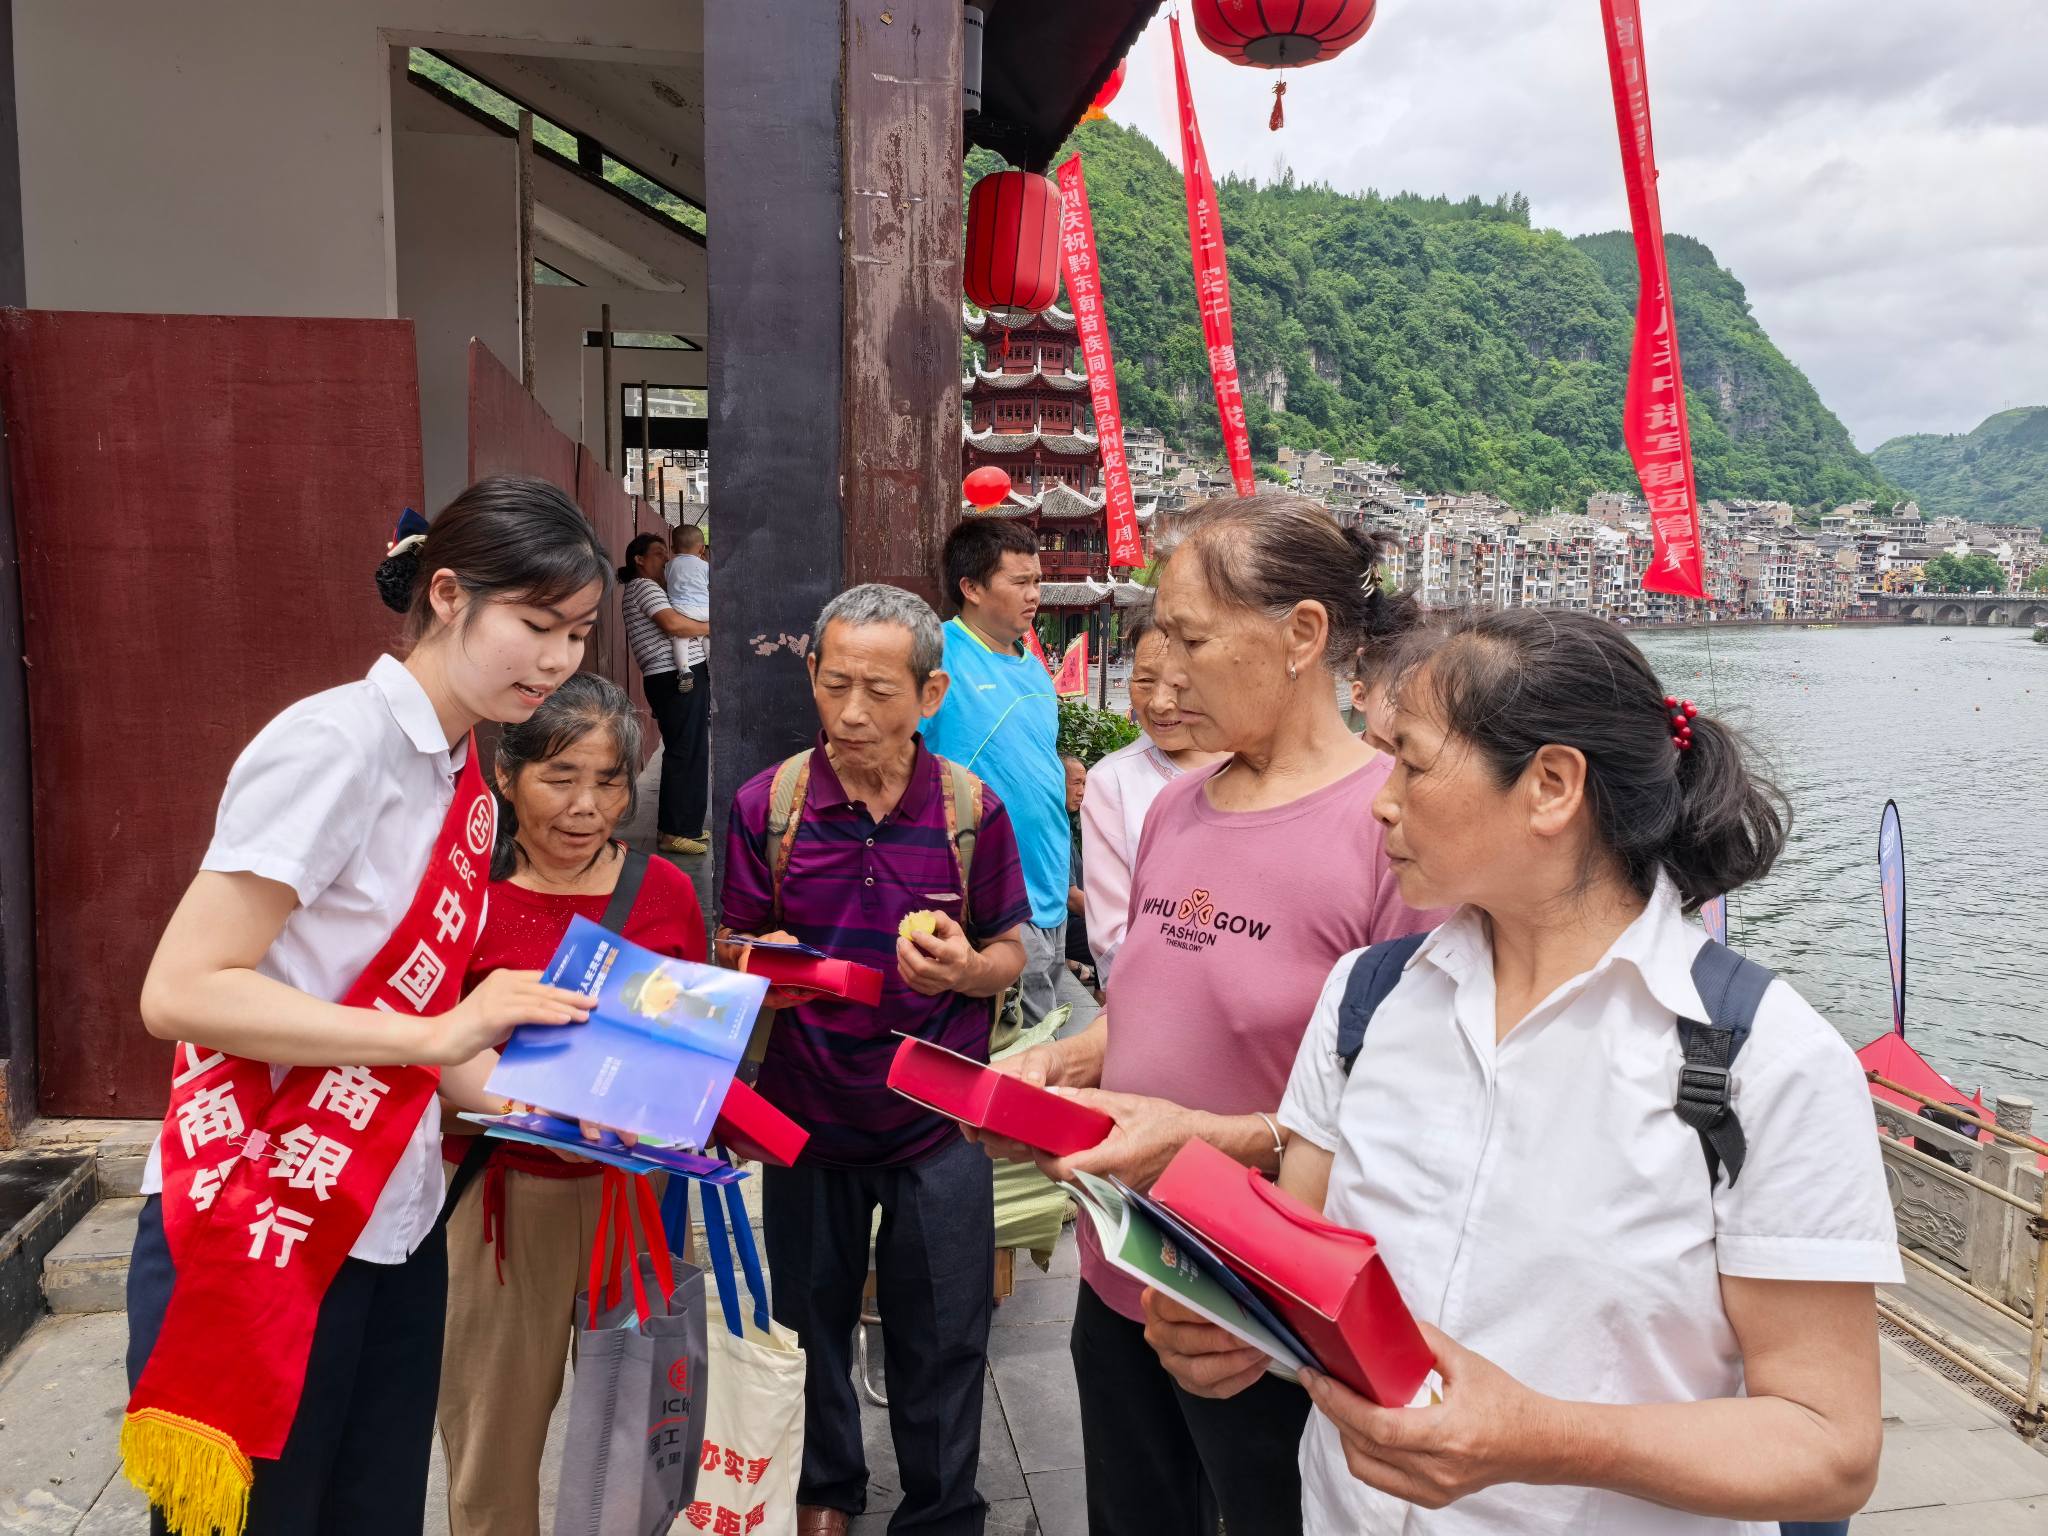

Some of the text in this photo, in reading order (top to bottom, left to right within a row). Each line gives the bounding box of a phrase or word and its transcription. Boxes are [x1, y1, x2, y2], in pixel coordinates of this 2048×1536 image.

[448, 843, 478, 890] ICBC
[1142, 898, 1272, 941] WHU GOW
[1160, 924, 1217, 947] FASHION
